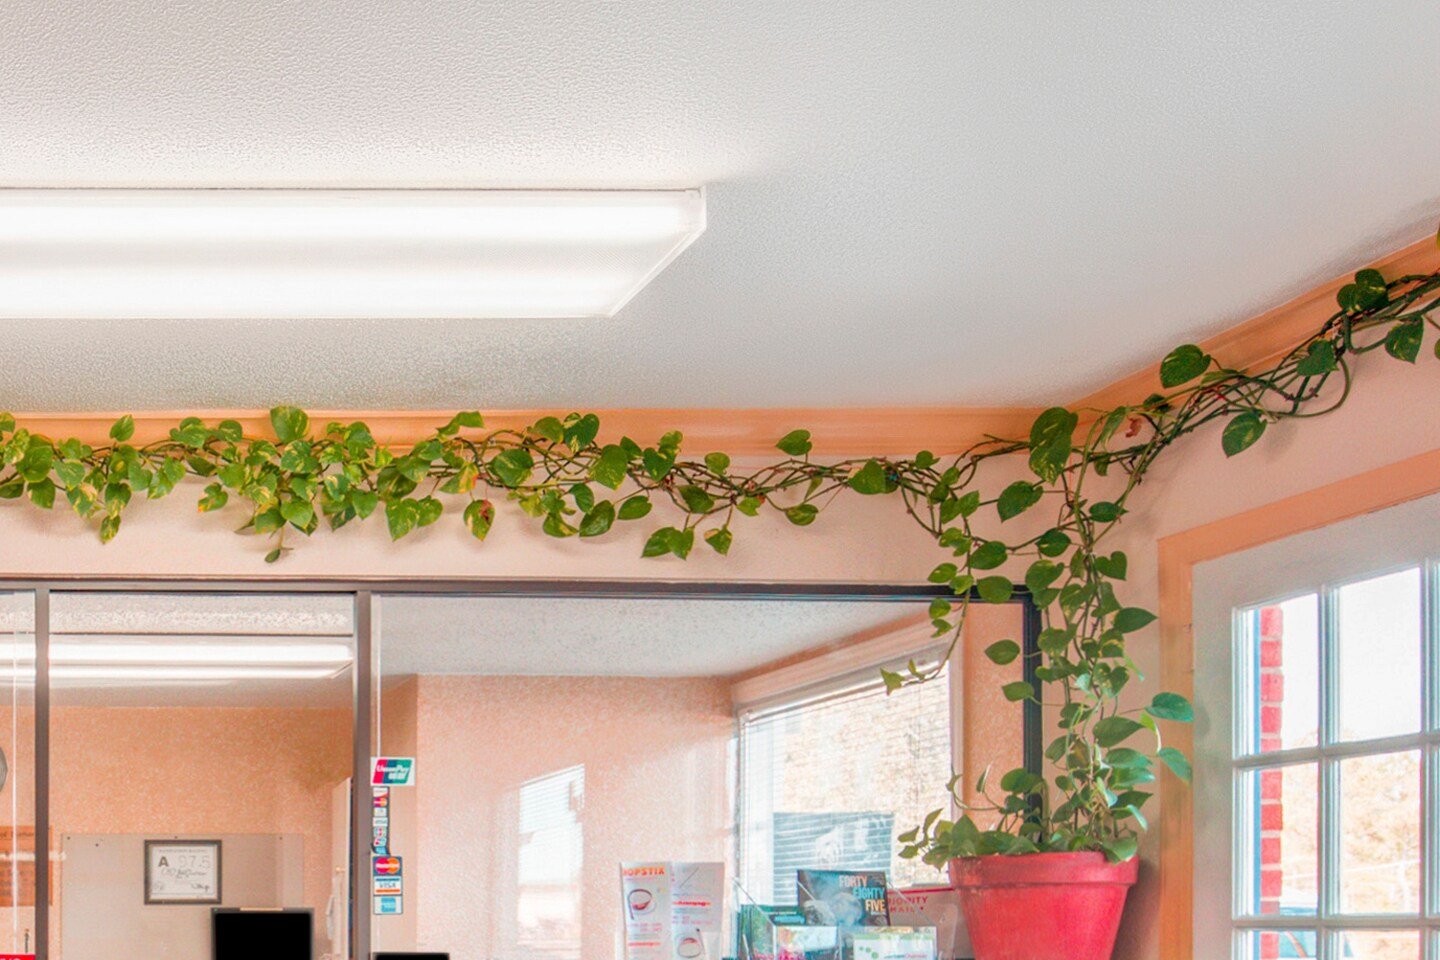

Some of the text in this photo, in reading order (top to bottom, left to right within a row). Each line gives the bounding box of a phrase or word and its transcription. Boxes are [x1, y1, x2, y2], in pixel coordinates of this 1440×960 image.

[158, 856, 169, 867] A
[839, 875, 868, 887] FORTY
[853, 887, 885, 899] EIGHTY
[865, 899, 886, 912] FIVE
